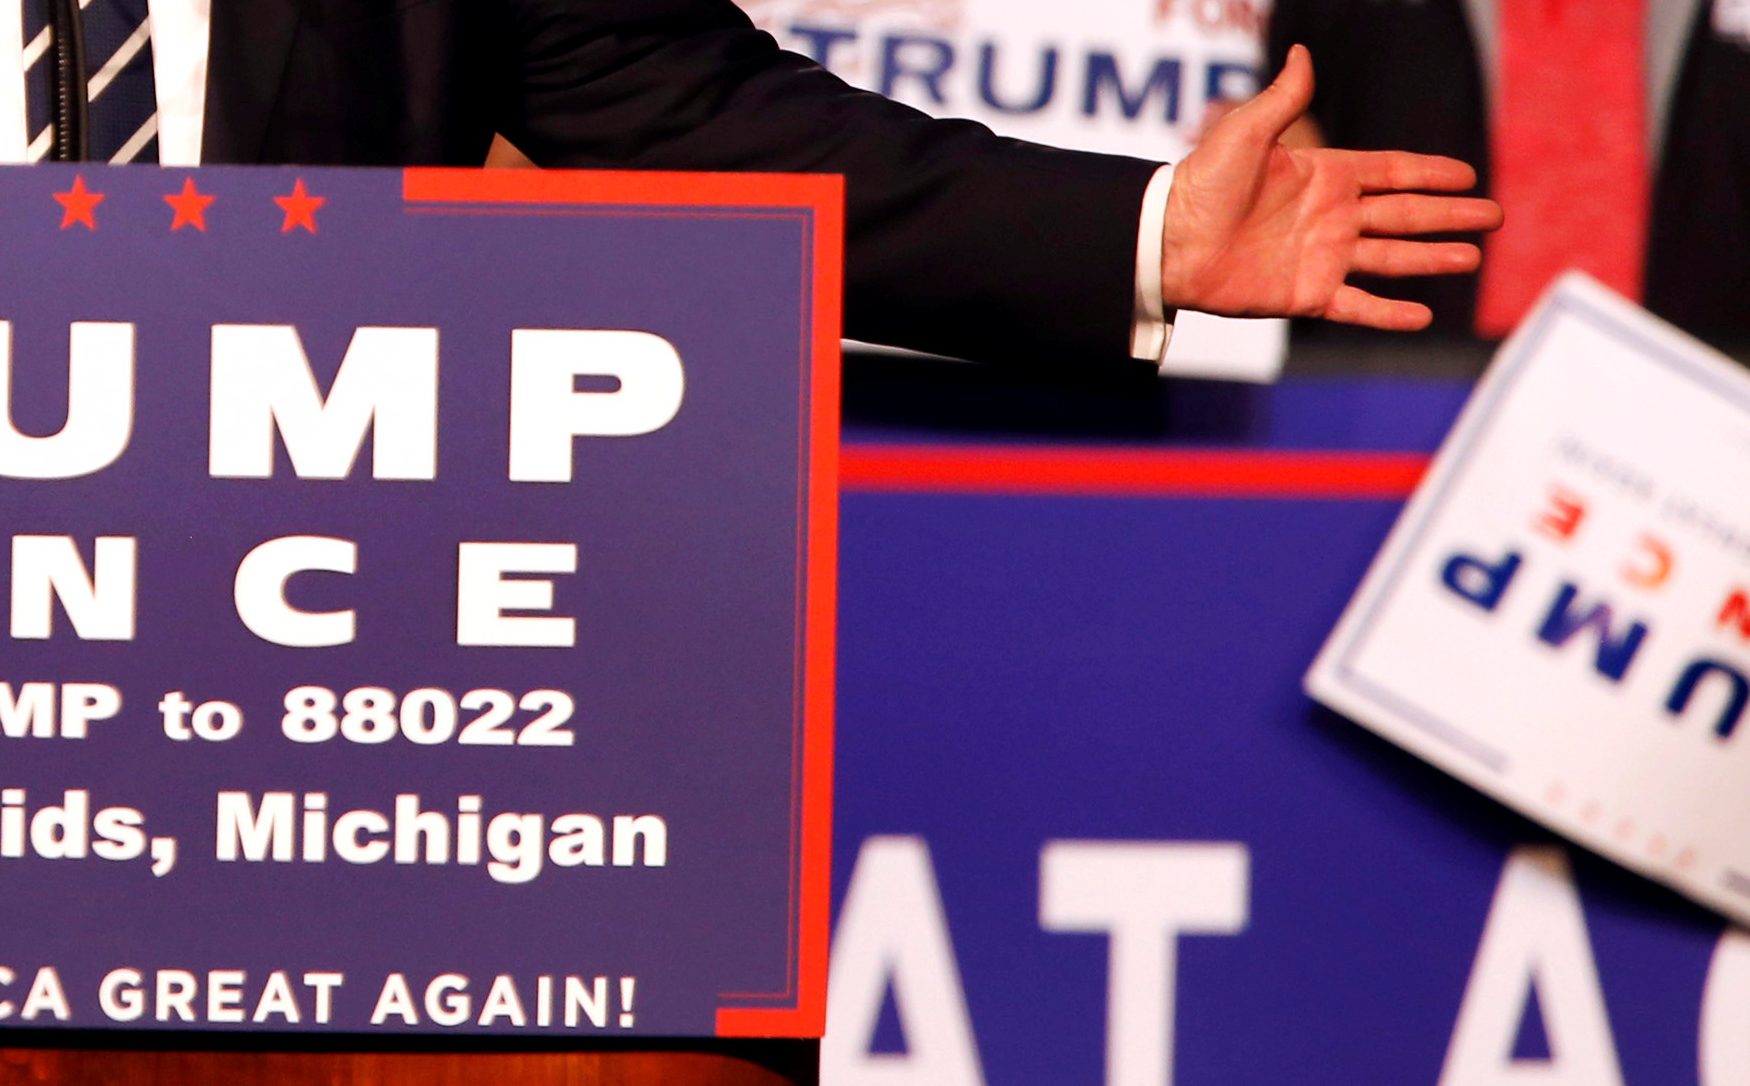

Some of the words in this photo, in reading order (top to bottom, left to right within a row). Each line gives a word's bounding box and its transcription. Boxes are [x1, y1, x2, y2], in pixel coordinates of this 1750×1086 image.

[157, 690, 242, 742] to
[280, 685, 575, 747] 88022
[215, 791, 668, 885] Michigan
[98, 968, 344, 1025] GREAT
[369, 973, 638, 1030] AGAIN!
